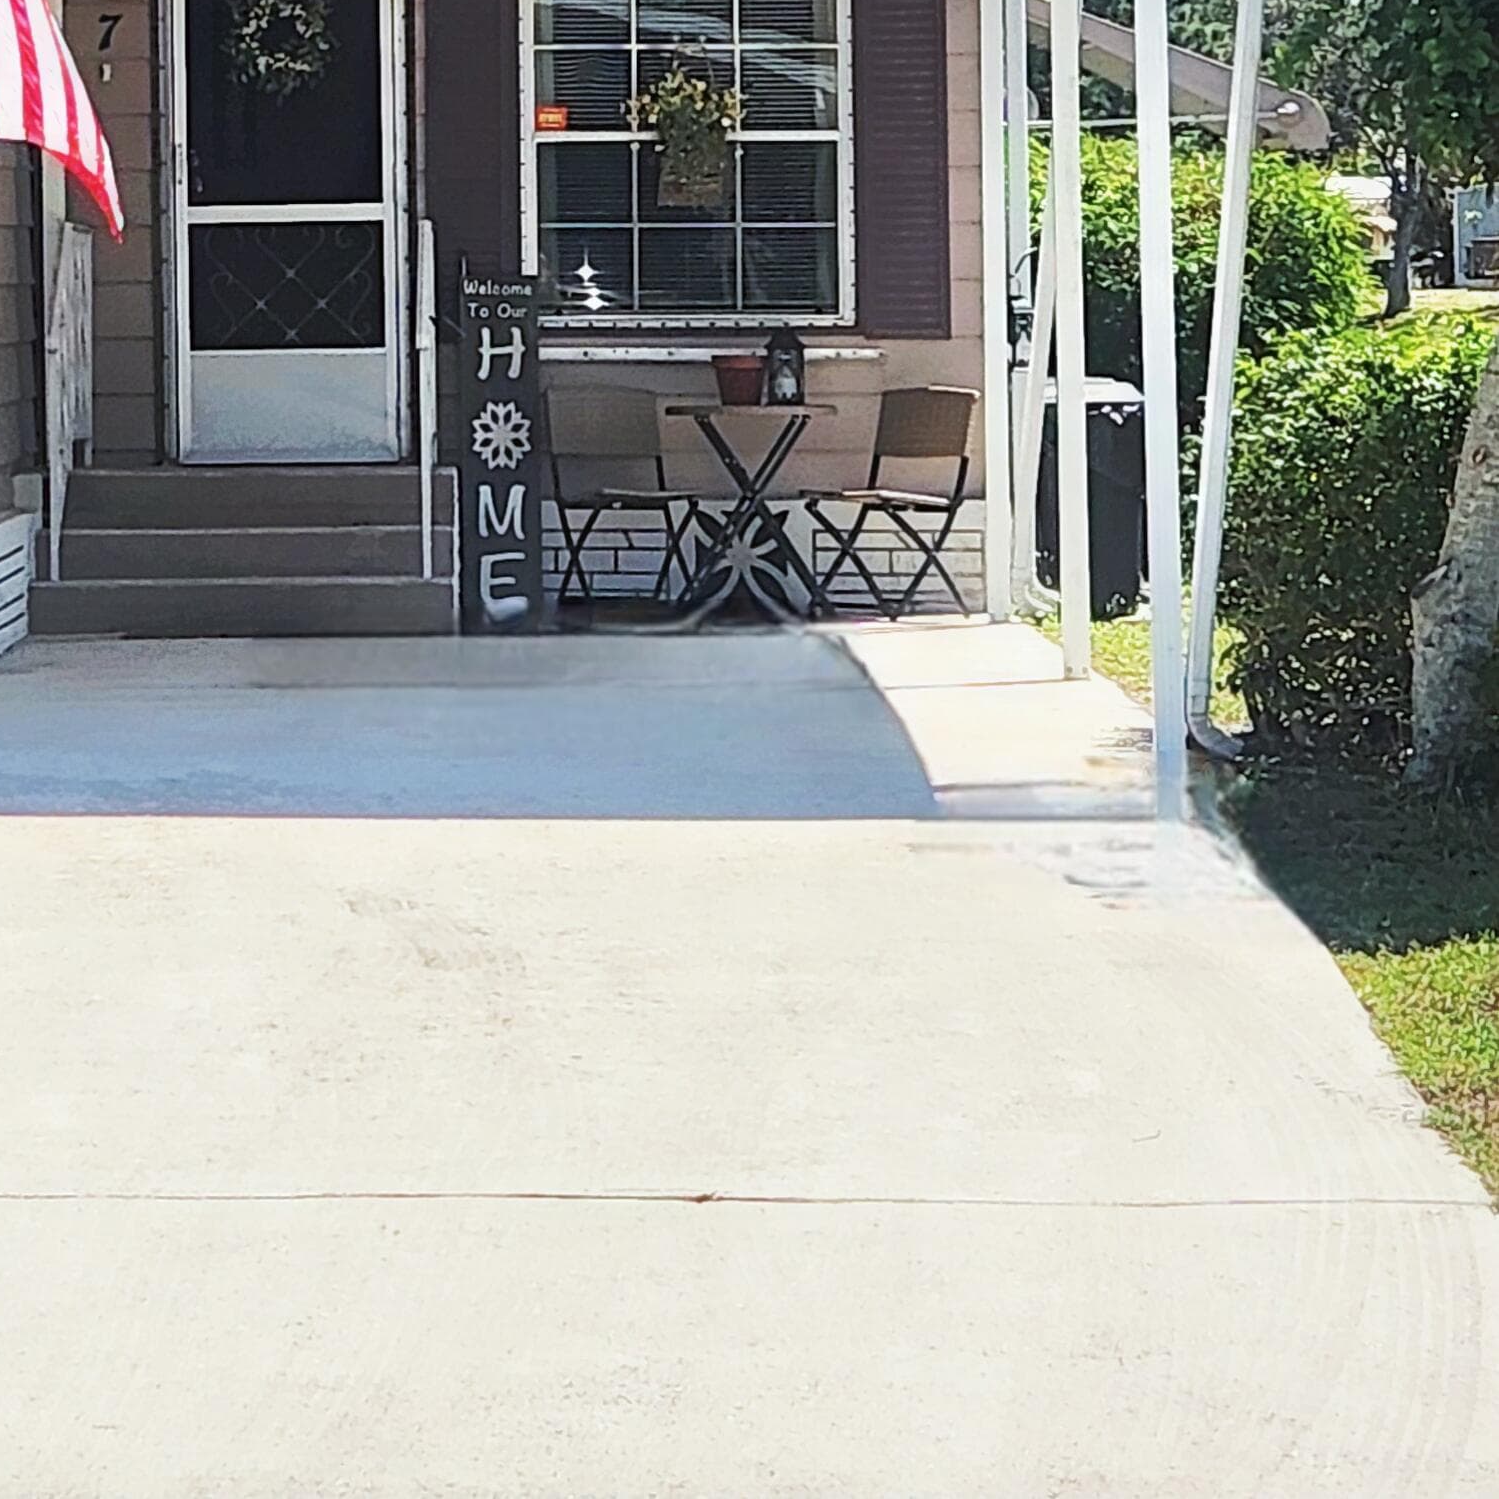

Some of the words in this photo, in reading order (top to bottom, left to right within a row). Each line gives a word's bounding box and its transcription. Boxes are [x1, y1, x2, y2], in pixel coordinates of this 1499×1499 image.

[98, 13, 123, 51] 7
[463, 279, 533, 296] Welcome
[467, 302, 489, 318] To
[496, 302, 527, 318] Our
